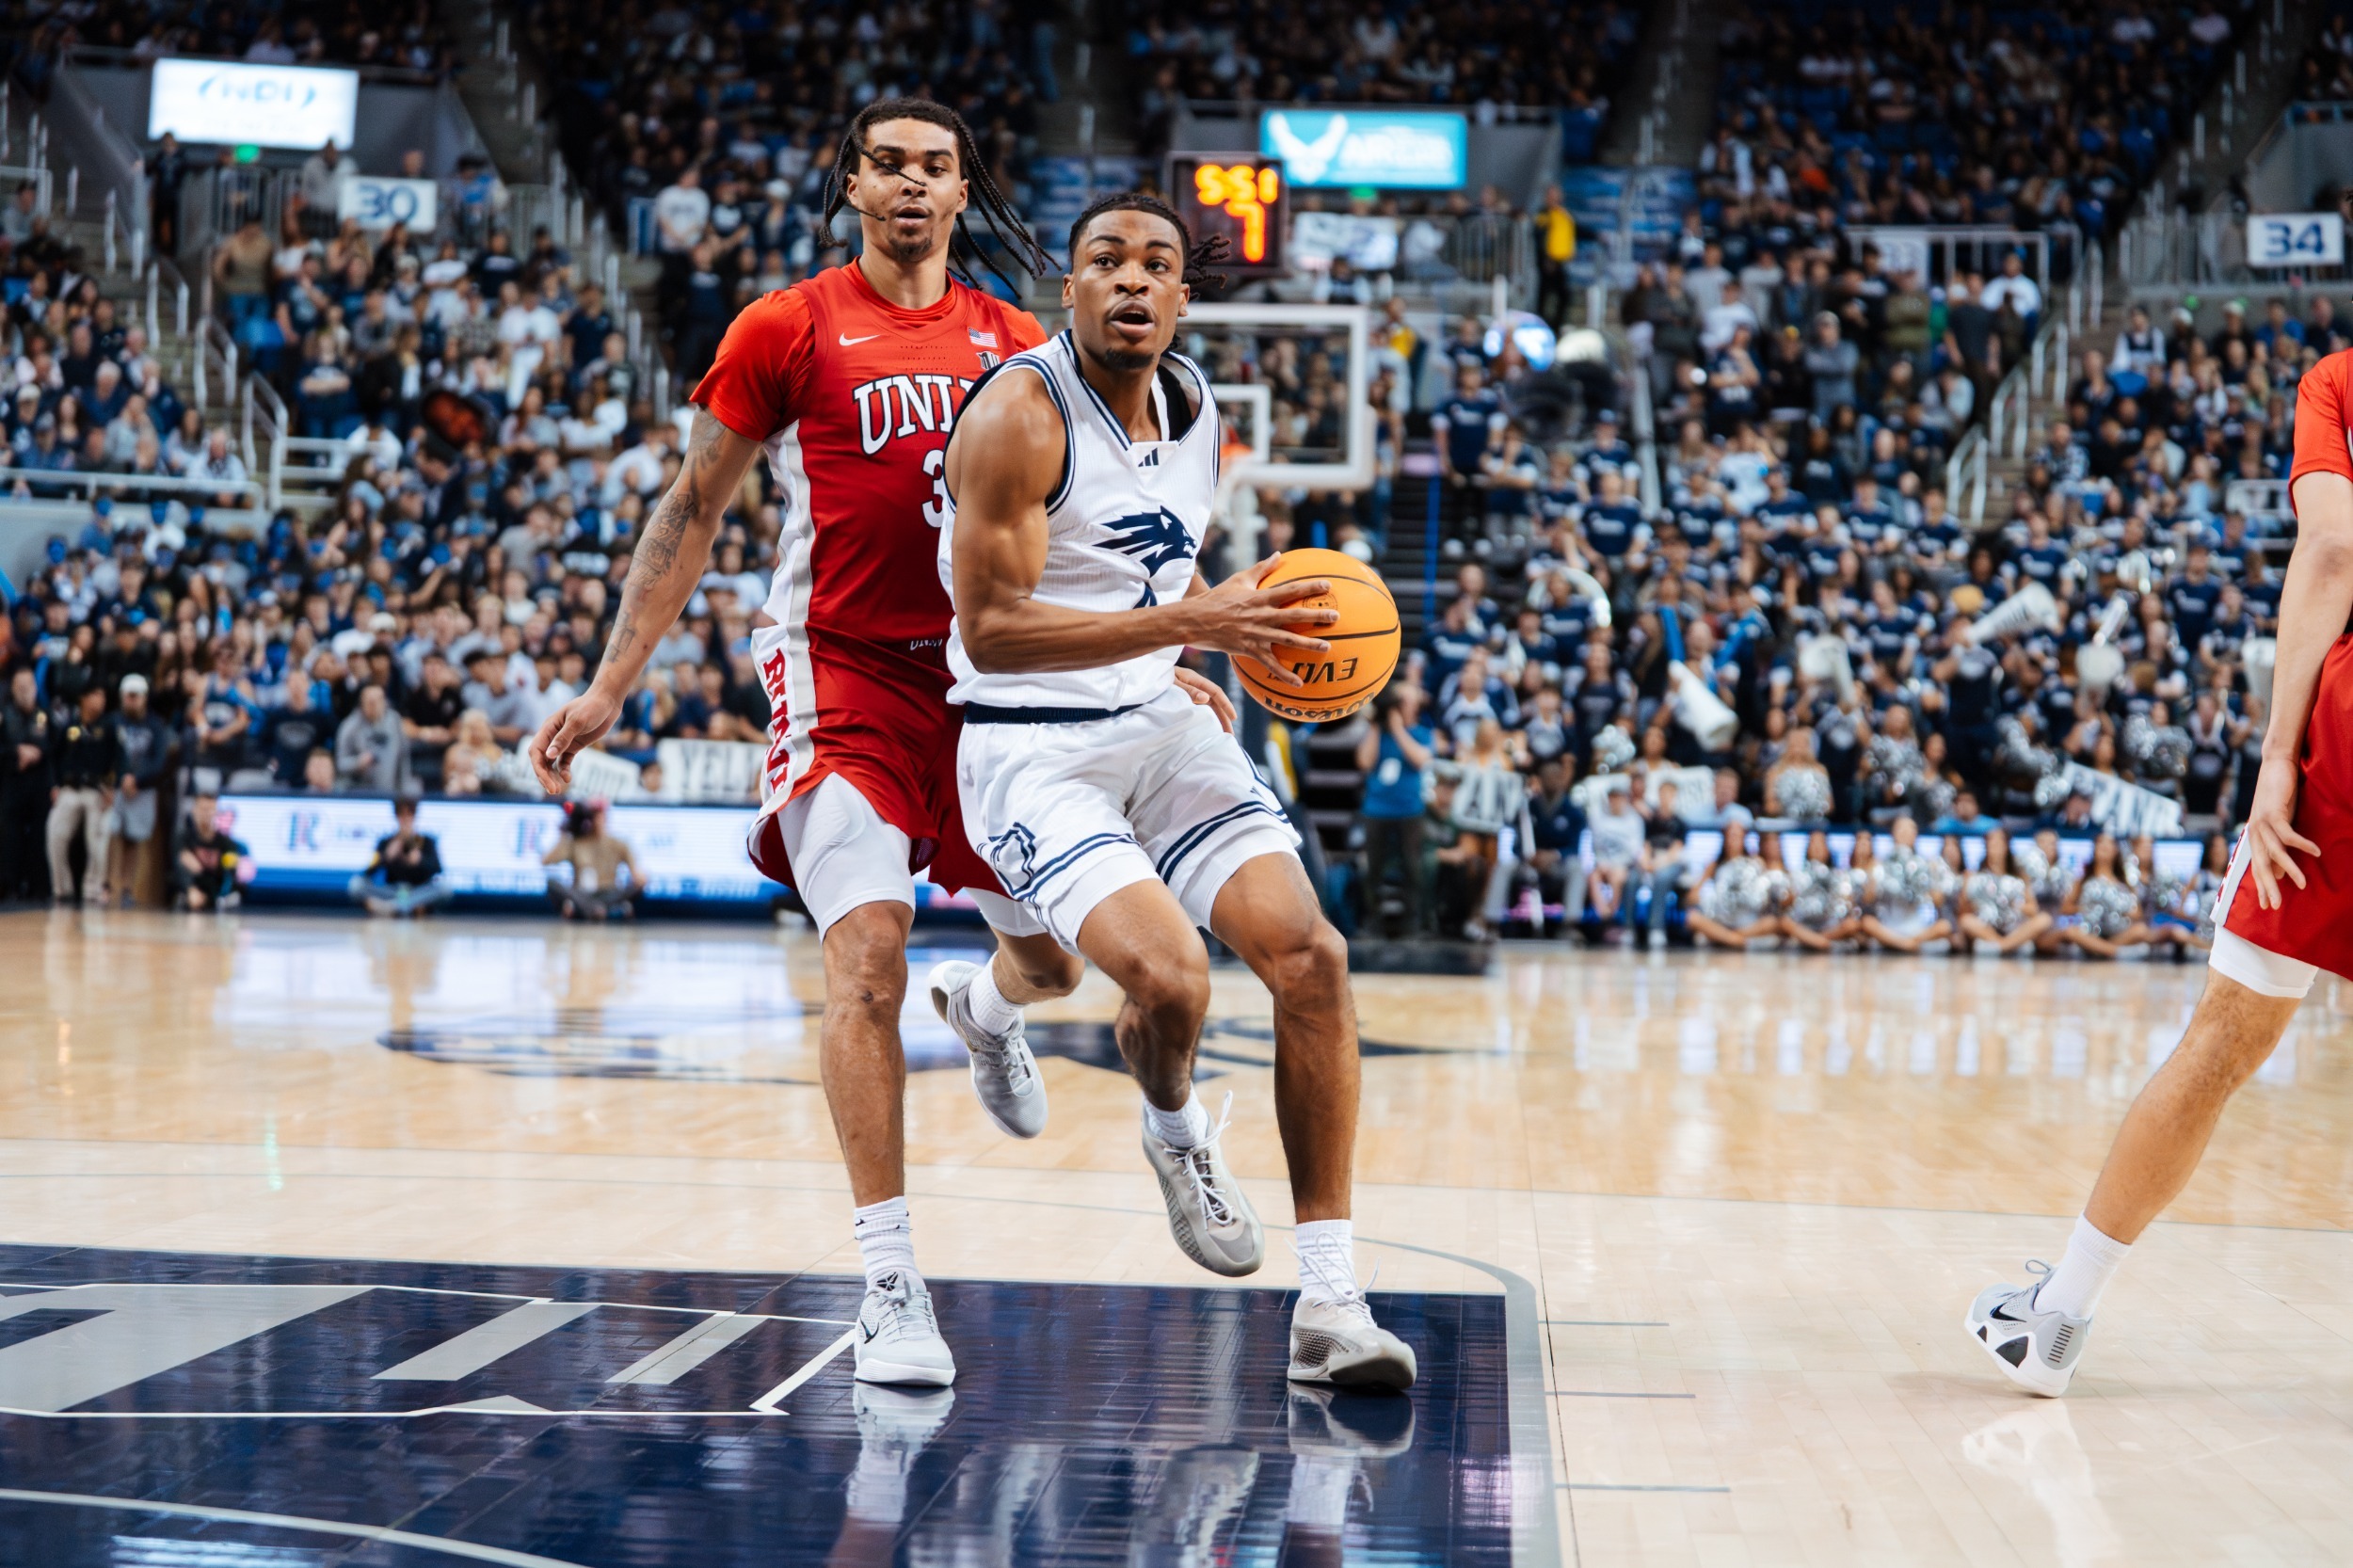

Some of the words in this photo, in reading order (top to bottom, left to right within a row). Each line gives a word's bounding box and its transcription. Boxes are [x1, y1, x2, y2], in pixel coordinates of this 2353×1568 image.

[358, 183, 420, 222] 30
[1225, 201, 1266, 262] 7
[2264, 221, 2324, 257] 34
[853, 373, 975, 456] UNL
